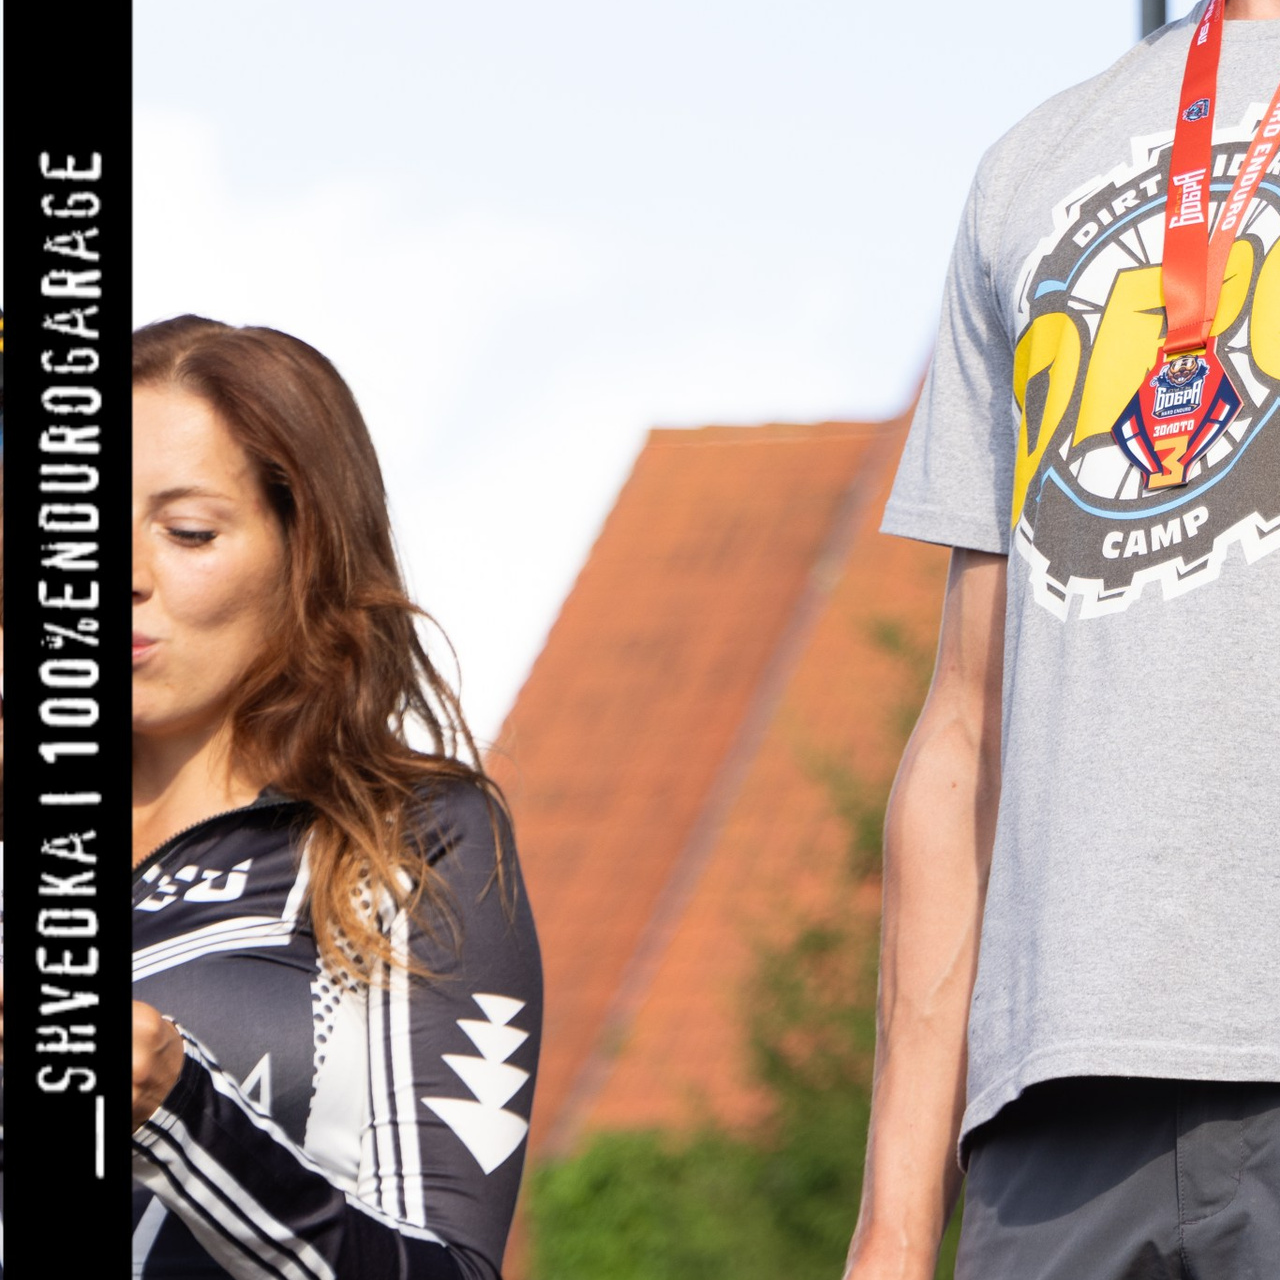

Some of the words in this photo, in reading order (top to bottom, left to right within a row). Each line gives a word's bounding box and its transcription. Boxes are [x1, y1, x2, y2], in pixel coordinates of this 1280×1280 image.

[1072, 173, 1162, 248] DIRT
[1168, 168, 1206, 229] БОБРА
[1221, 143, 1273, 232] ENDURO
[1155, 379, 1203, 411] БОБРА
[1161, 408, 1174, 417] HARD
[1174, 406, 1192, 414] ENDURO
[1153, 419, 1195, 437] ЗОЛОТО
[1148, 435, 1189, 488] 3
[1101, 505, 1209, 559] CAMP
